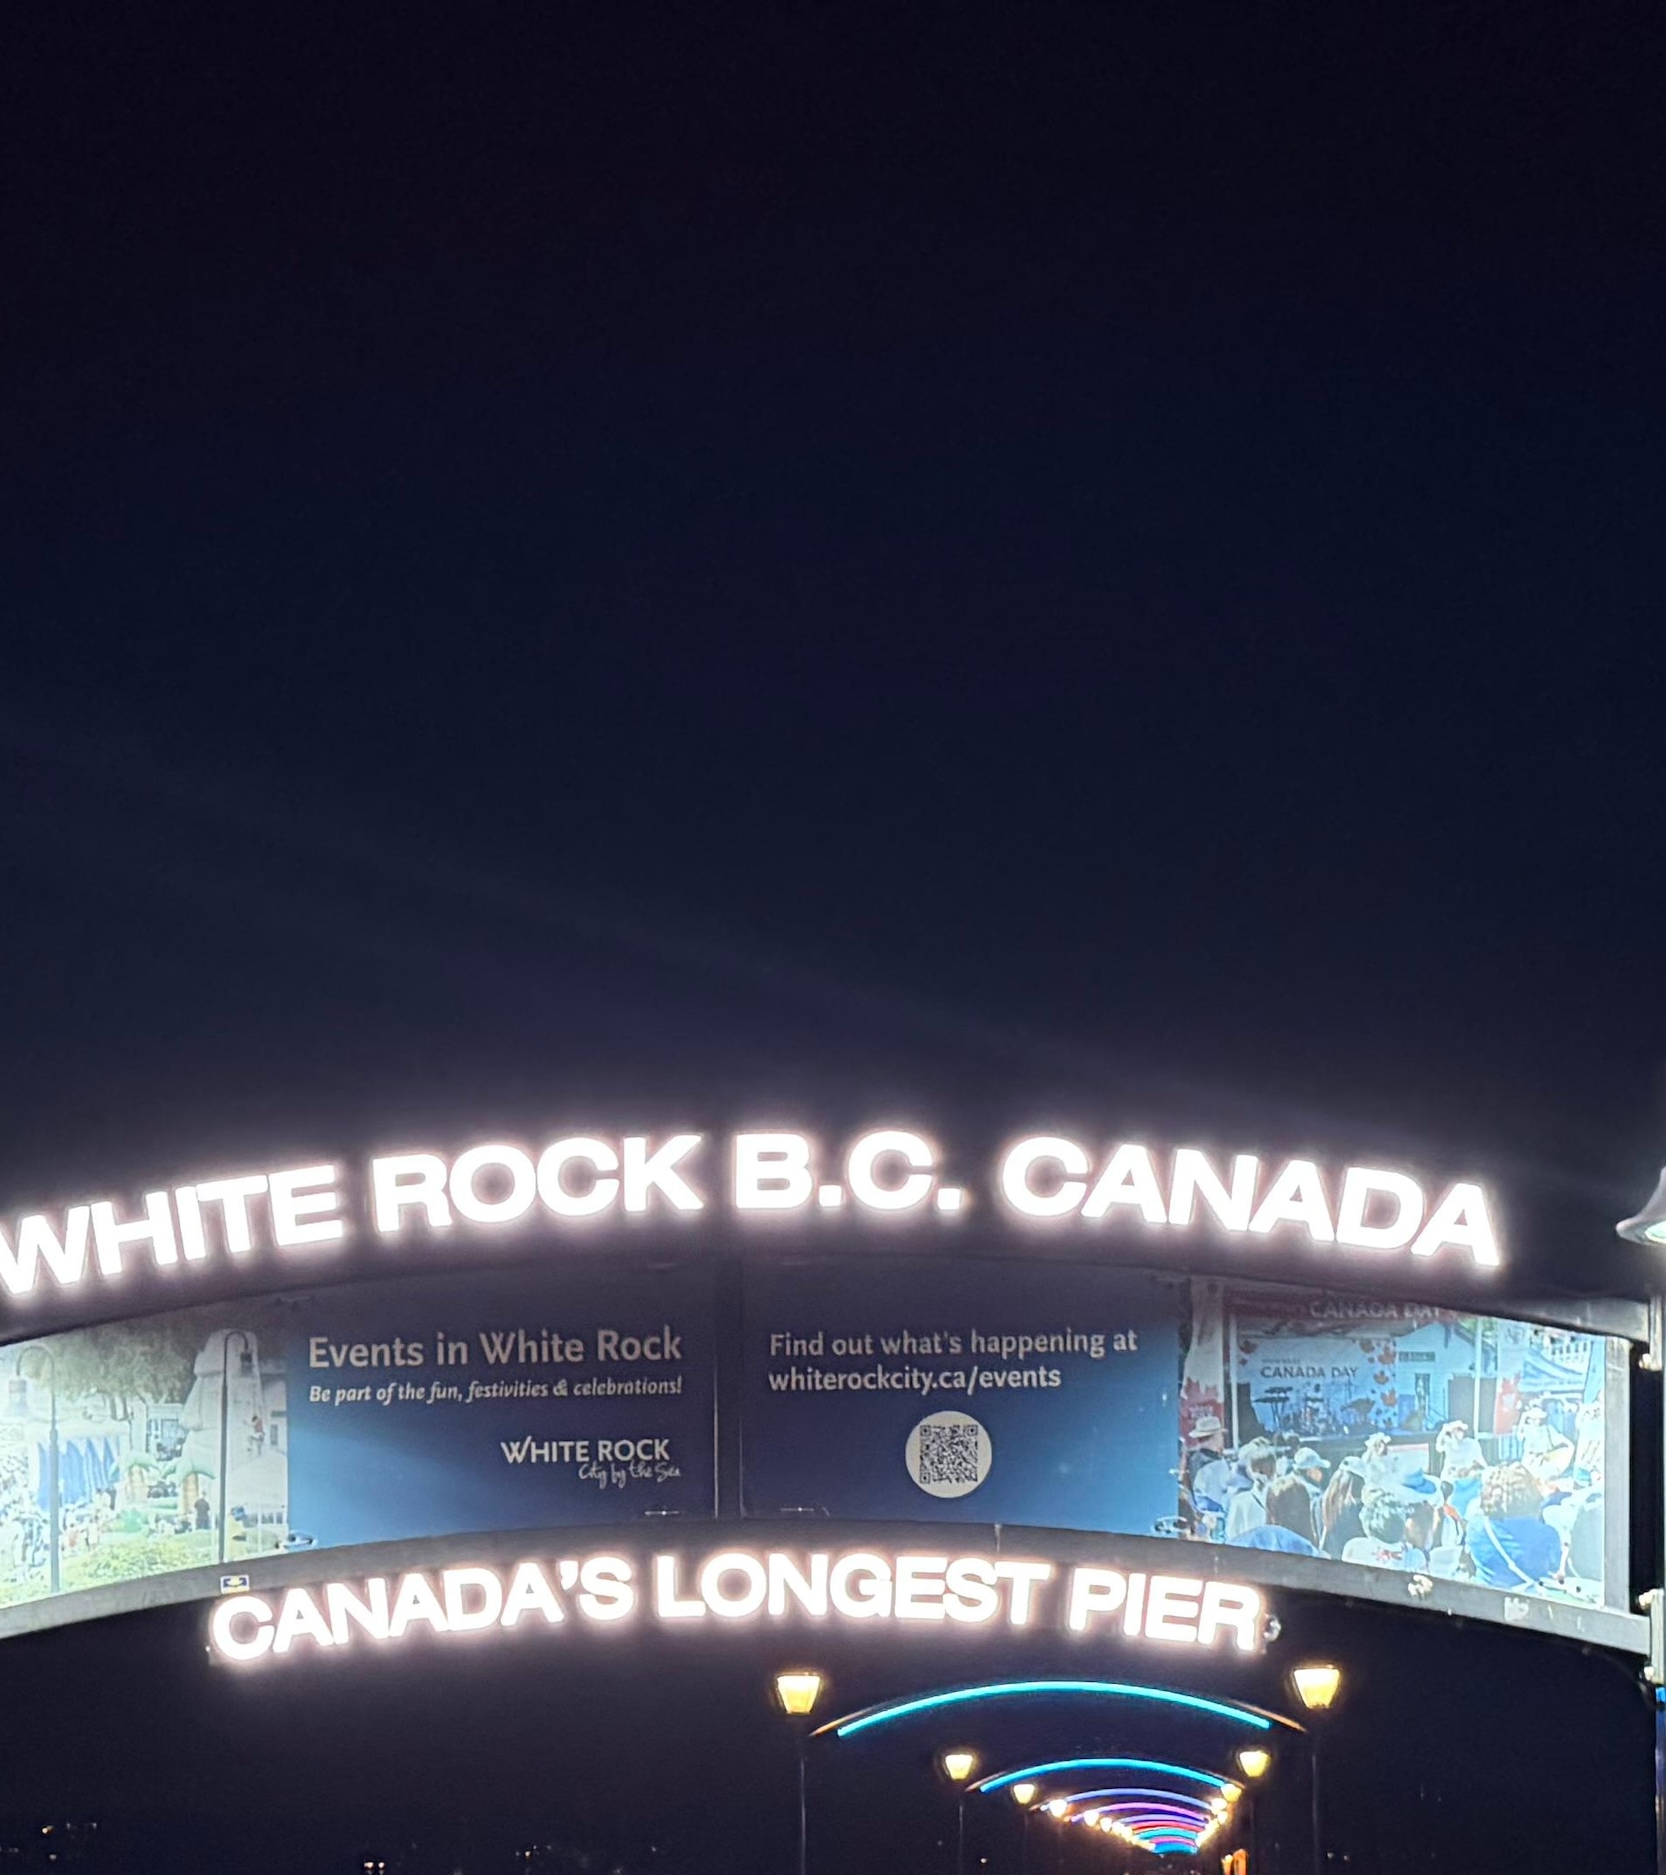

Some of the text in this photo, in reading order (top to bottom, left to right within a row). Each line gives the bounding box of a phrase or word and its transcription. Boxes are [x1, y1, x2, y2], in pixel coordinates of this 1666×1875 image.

[371, 1134, 704, 1233] ROCK
[734, 1130, 962, 1211] B.C.
[1001, 1136, 1500, 1267] CANADA
[309, 1325, 682, 1369] Events in White Rock
[770, 1327, 1138, 1360] Find out what's happening at
[768, 1365, 1062, 1396] whiterockcity.ca/events
[1260, 1365, 1359, 1379] CANADA DAY
[309, 1375, 682, 1406] Be part of the fun, festivities & celebrations!
[501, 1436, 670, 1463] WHITE ROCK
[212, 1552, 1261, 1662] CANADA'S LONGEST PIER
